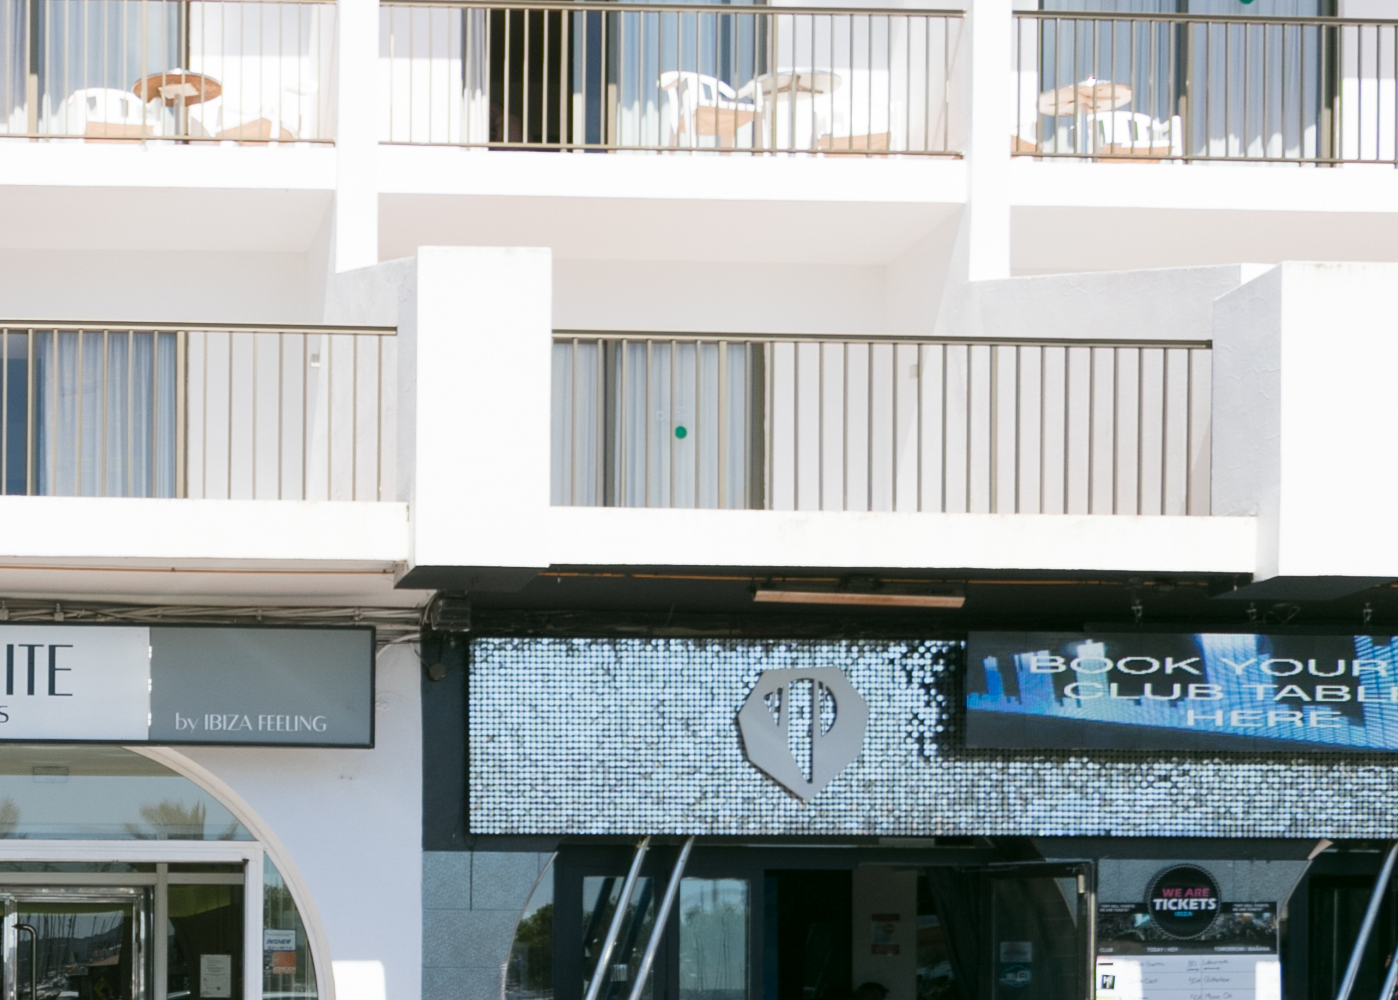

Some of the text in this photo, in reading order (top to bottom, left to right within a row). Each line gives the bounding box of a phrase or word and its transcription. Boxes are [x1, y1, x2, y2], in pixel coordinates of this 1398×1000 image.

[1029, 655, 1389, 678] BOOK YOUR
[1063, 682, 1224, 701] CLUB
[175, 712, 327, 735] by IBIZA FEELING
[1187, 709, 1344, 729] HERE
[1162, 888, 1210, 898] WE ARE
[1152, 898, 1217, 911] TICKETS
